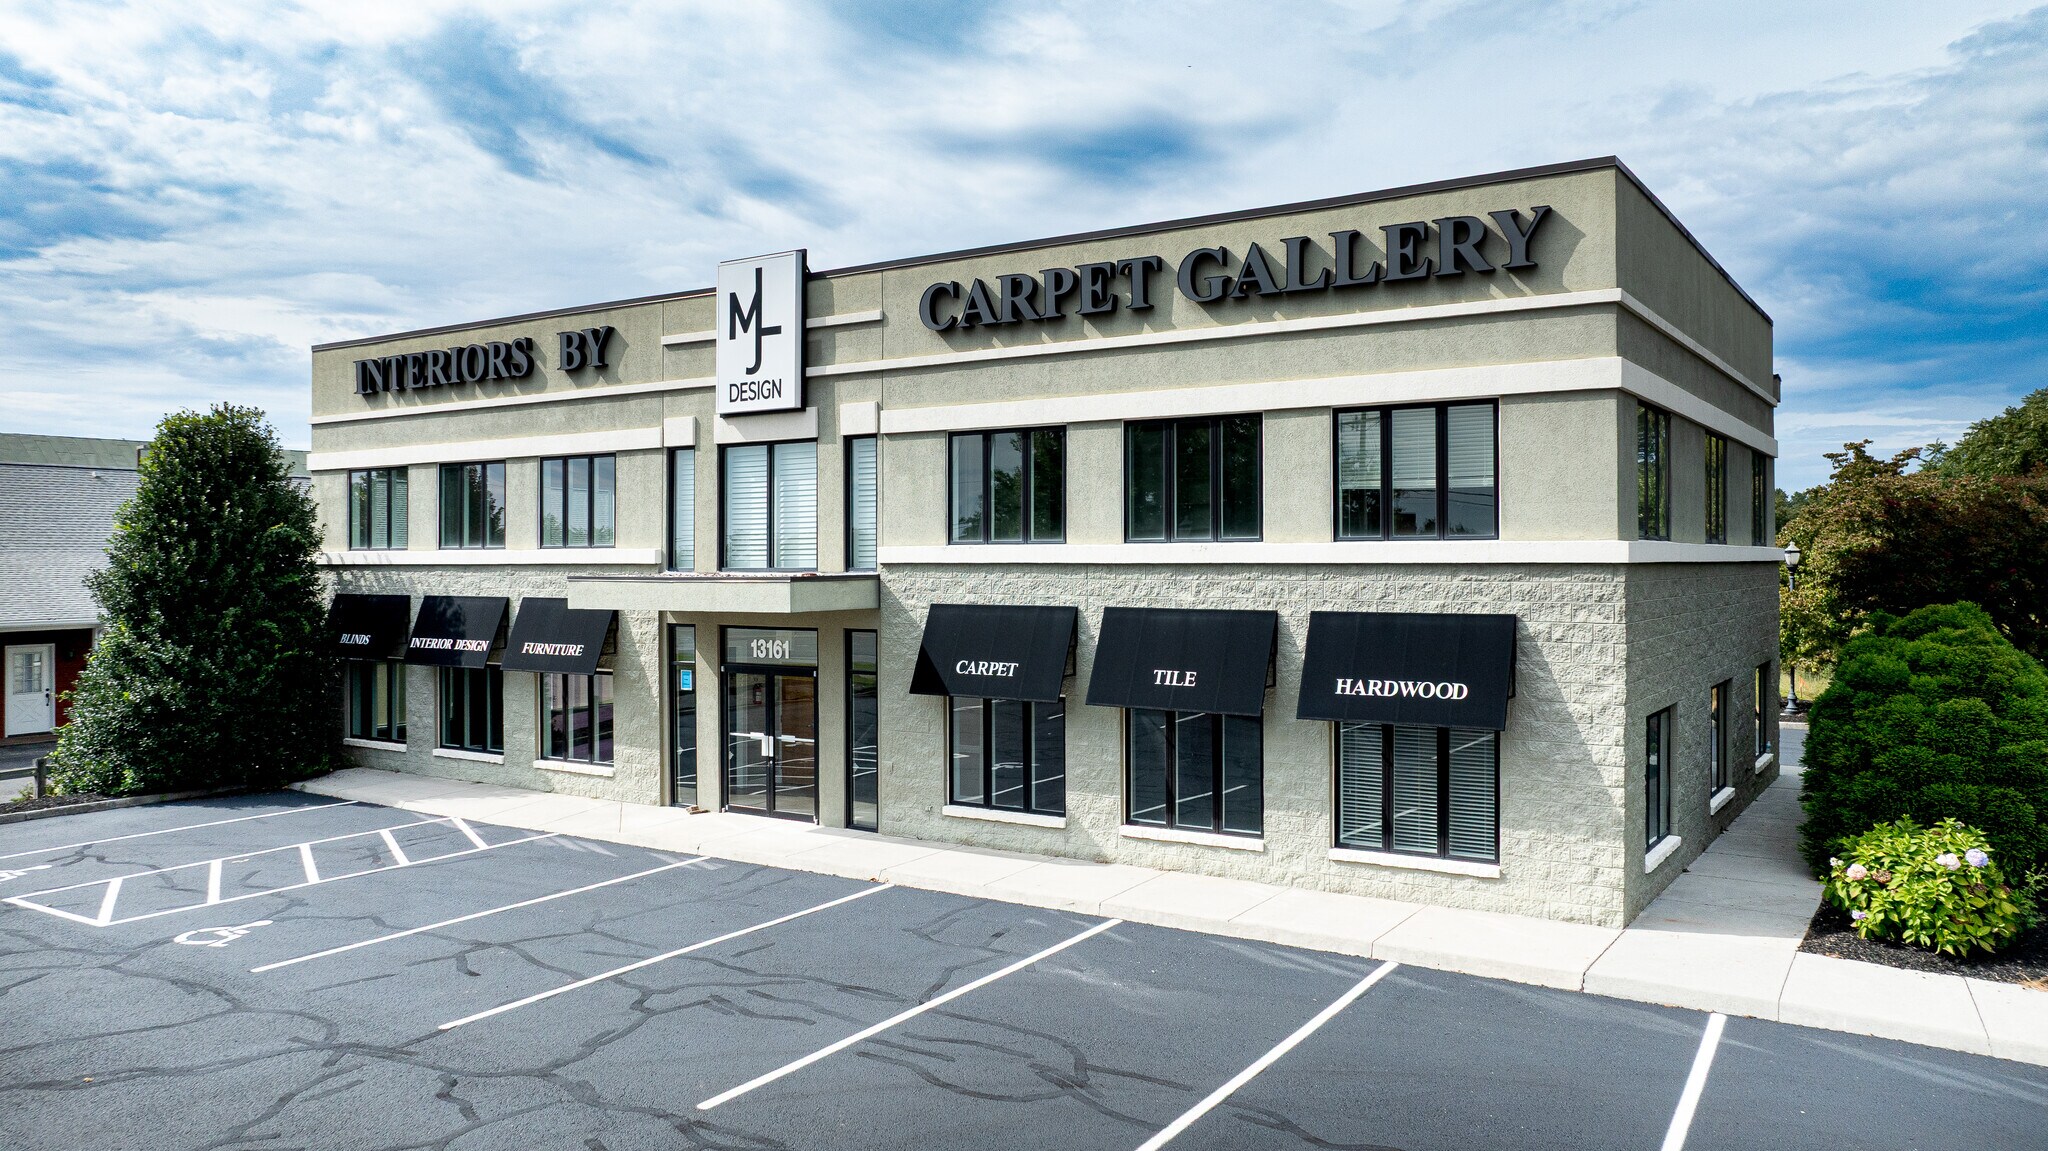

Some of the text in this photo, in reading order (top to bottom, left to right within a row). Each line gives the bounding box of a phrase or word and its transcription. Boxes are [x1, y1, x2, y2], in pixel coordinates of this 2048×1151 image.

[918, 205, 1552, 332] CARPET GALLERY
[353, 325, 614, 396] INTERIORS BY
[729, 378, 782, 403] DESIGN
[339, 633, 371, 645] BLINDS
[409, 637, 490, 652] INTERIOR DESIGN
[750, 638, 790, 659] 13161
[521, 642, 584, 657] FURNITURE
[955, 659, 1019, 677] CARPET
[1153, 669, 1197, 687] TILE
[1335, 678, 1469, 700] HARDWOOD
